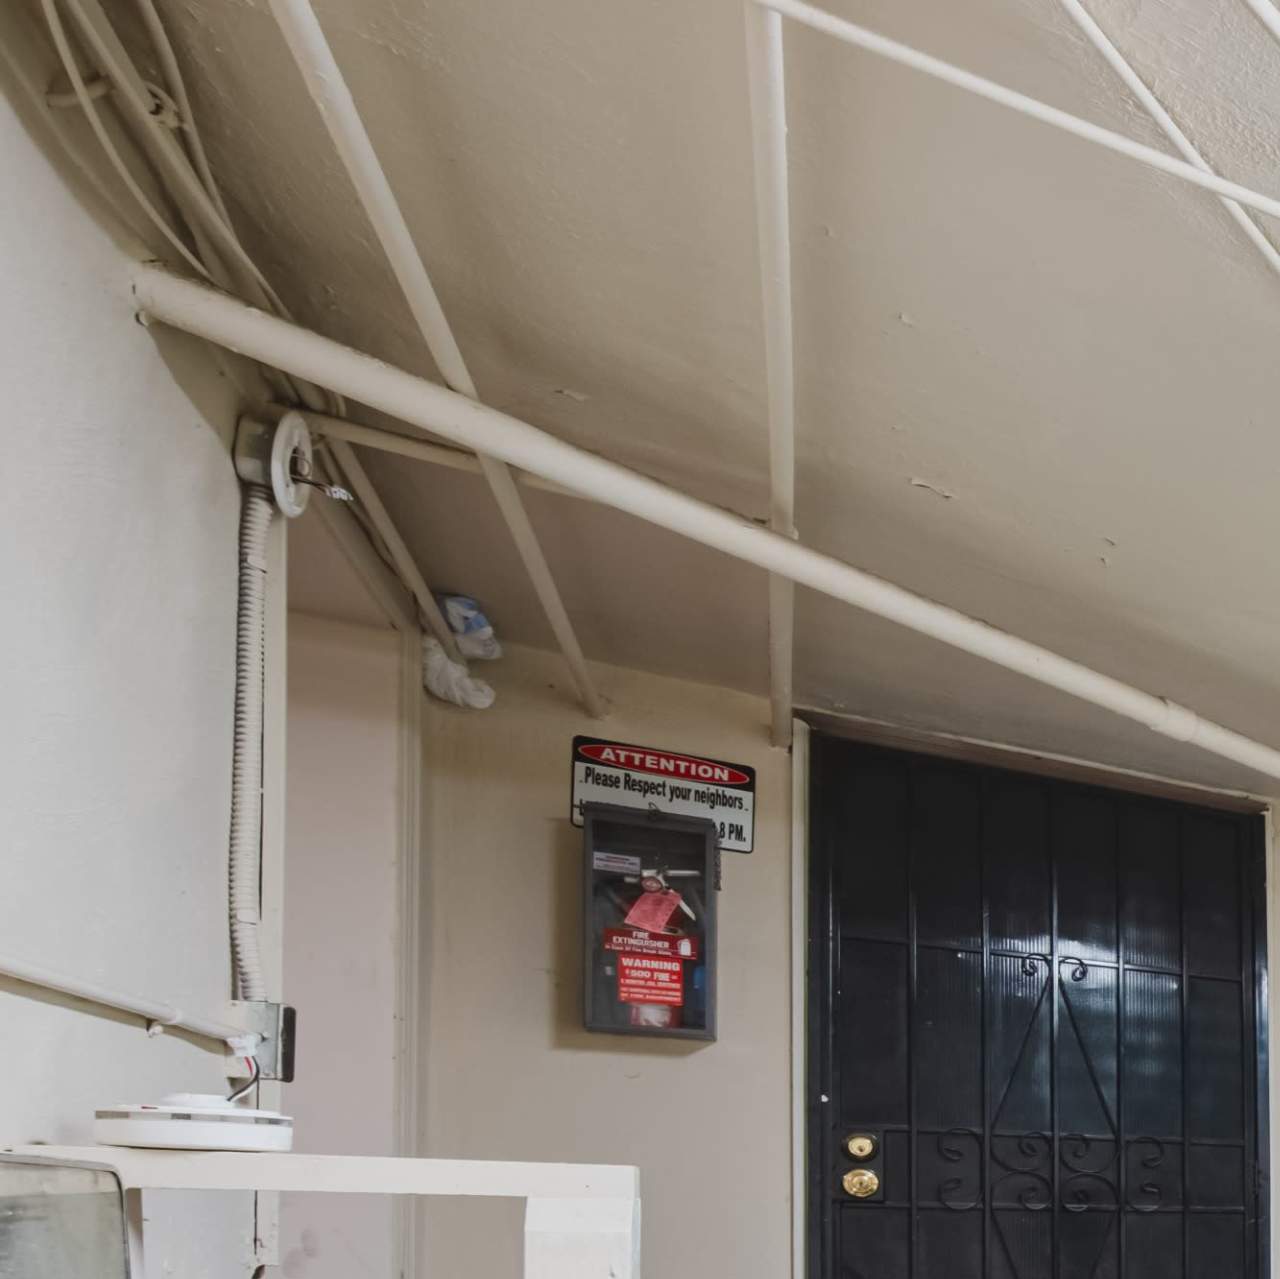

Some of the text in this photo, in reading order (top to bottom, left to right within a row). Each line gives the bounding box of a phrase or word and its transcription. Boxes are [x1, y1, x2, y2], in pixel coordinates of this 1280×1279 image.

[601, 747, 729, 781] ATTENTION
[584, 766, 743, 809] Please Respect your neighbors
[729, 825, 746, 842] PM.
[612, 936, 670, 949] EXTINGUISHER
[632, 930, 649, 940] FIRE
[621, 957, 680, 971] WARNING
